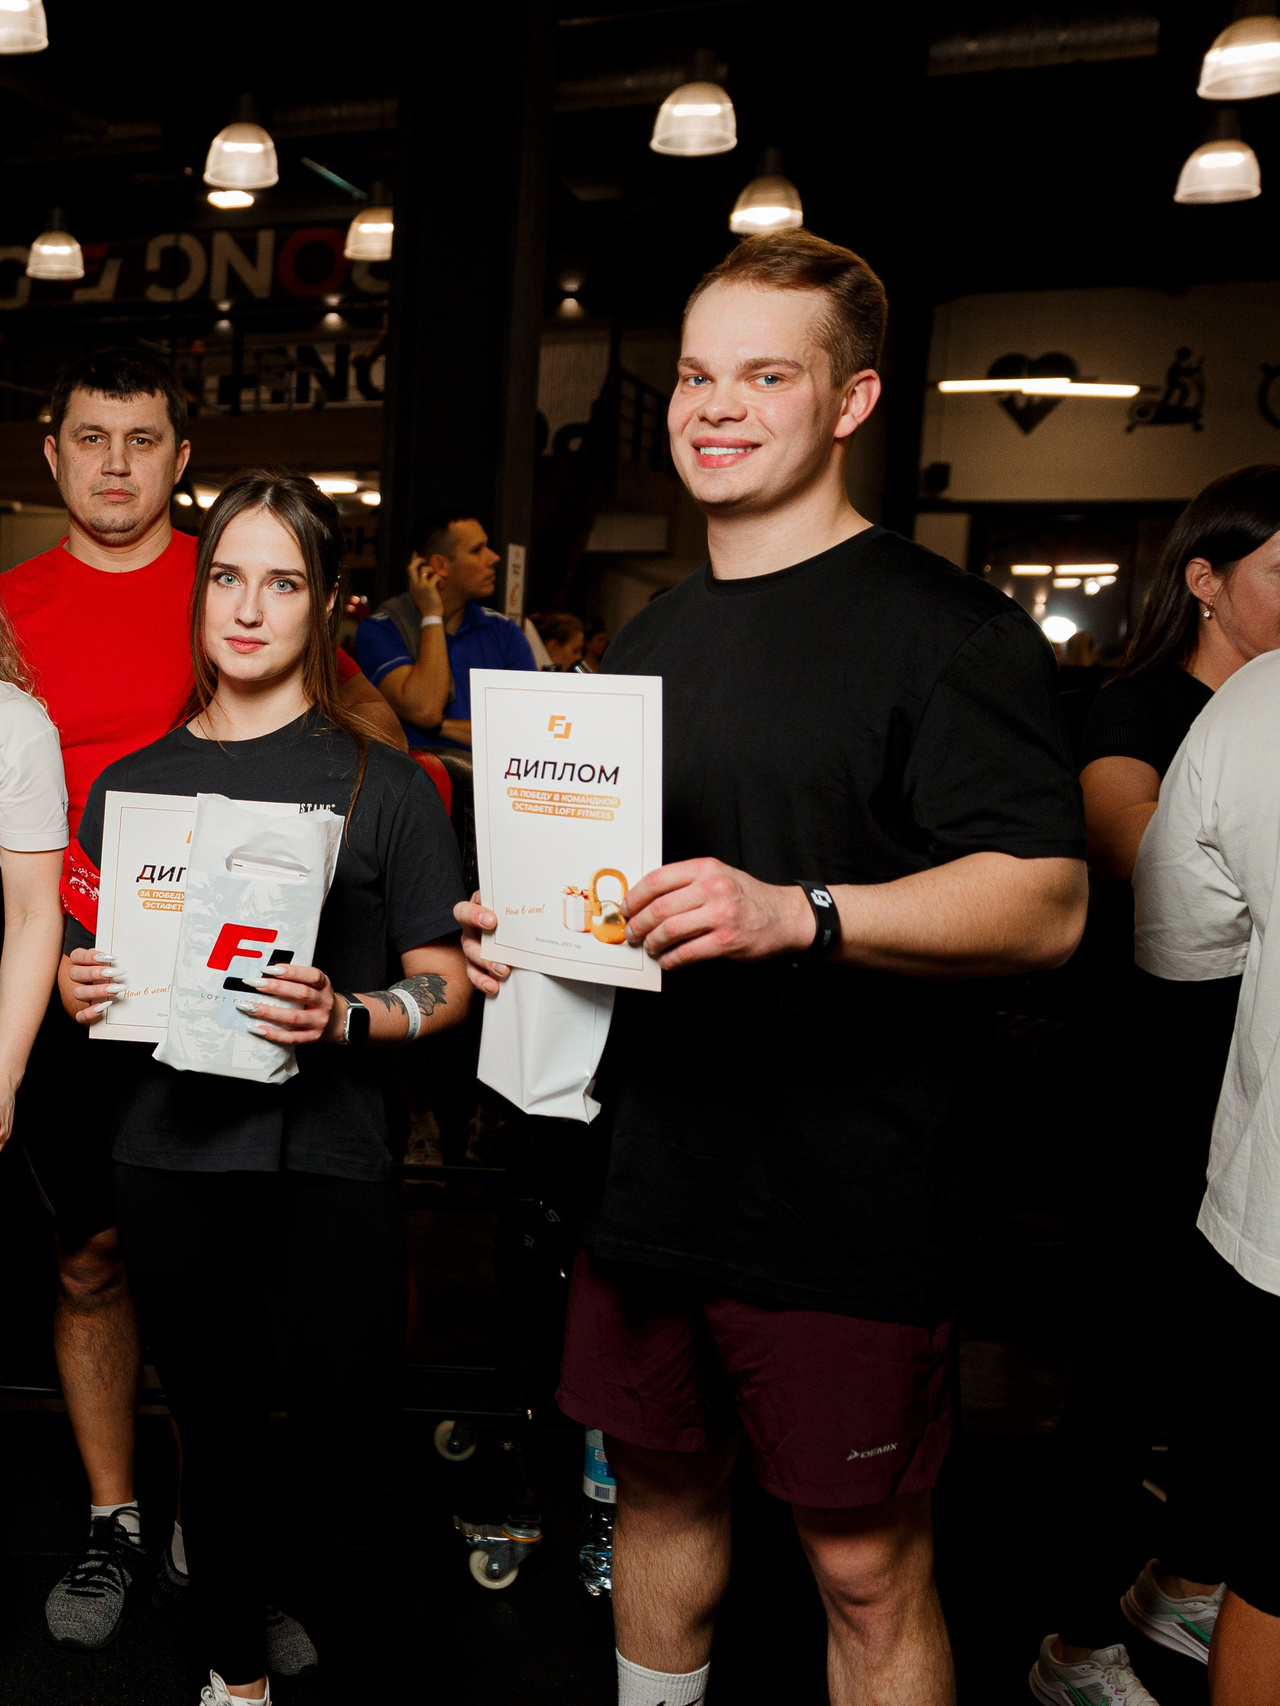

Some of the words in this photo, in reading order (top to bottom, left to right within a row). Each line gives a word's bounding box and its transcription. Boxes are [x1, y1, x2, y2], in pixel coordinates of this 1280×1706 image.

[504, 757, 620, 785] ДИПЛОМ
[508, 788, 519, 797] ЗА
[520, 790, 553, 801] ПОБЕДУ
[553, 793, 560, 801] В
[561, 794, 618, 807] КОМАНДНОЙ
[514, 802, 554, 814] ЭСТАФЕТЕ
[555, 806, 576, 816] LOFT
[577, 808, 612, 819] FITNESS
[144, 901, 183, 911] ЭСТАФЕТ
[200, 992, 226, 1002] LOFT
